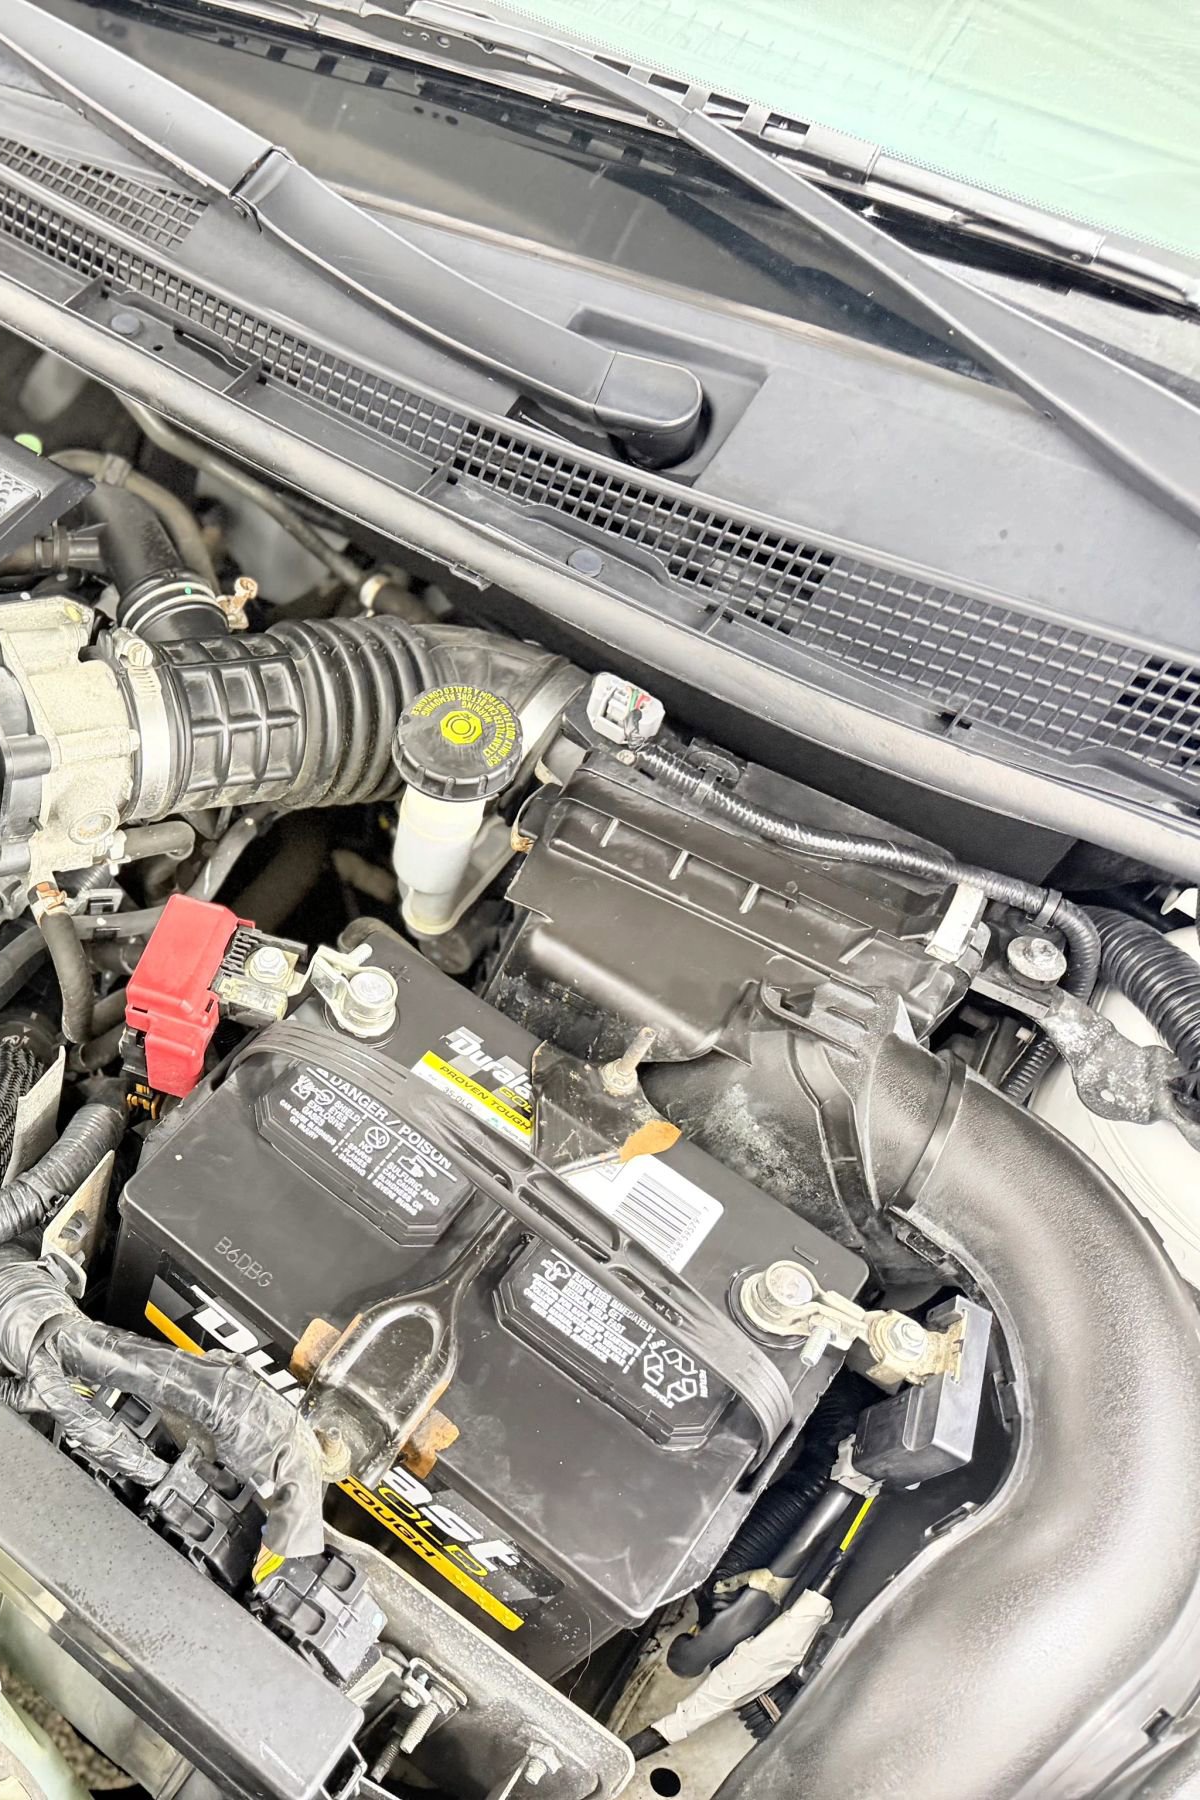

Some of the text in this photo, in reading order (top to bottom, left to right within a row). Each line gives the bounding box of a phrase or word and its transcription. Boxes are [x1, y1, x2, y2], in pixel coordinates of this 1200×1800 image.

[420, 693, 455, 716] REMOVING
[456, 692, 486, 707] BEFORE
[461, 700, 492, 723] WARNING
[483, 703, 498, 716] CAP
[447, 1030, 533, 1098] Durala
[439, 1064, 488, 1101] PROVEN
[490, 1100, 531, 1131] TOUGH
[300, 1105, 325, 1127] GASES
[306, 1099, 345, 1131] EXPLOSIVE
[327, 1105, 348, 1123] EYES
[330, 1075, 389, 1119] DANGER
[398, 1123, 452, 1170] POISON
[333, 1099, 361, 1123] SHIELD
[357, 1140, 373, 1154] NO
[381, 1167, 396, 1181] CAN
[385, 1160, 423, 1192] SULFURIC
[214, 1236, 273, 1287] B6DBG
[571, 1271, 595, 1292] FLUSH
[610, 1298, 653, 1333] IMMEDIATELY
[606, 1316, 626, 1335] FAST
[341, 1478, 438, 1558] TOUGH
[378, 1483, 488, 1576] OLD
